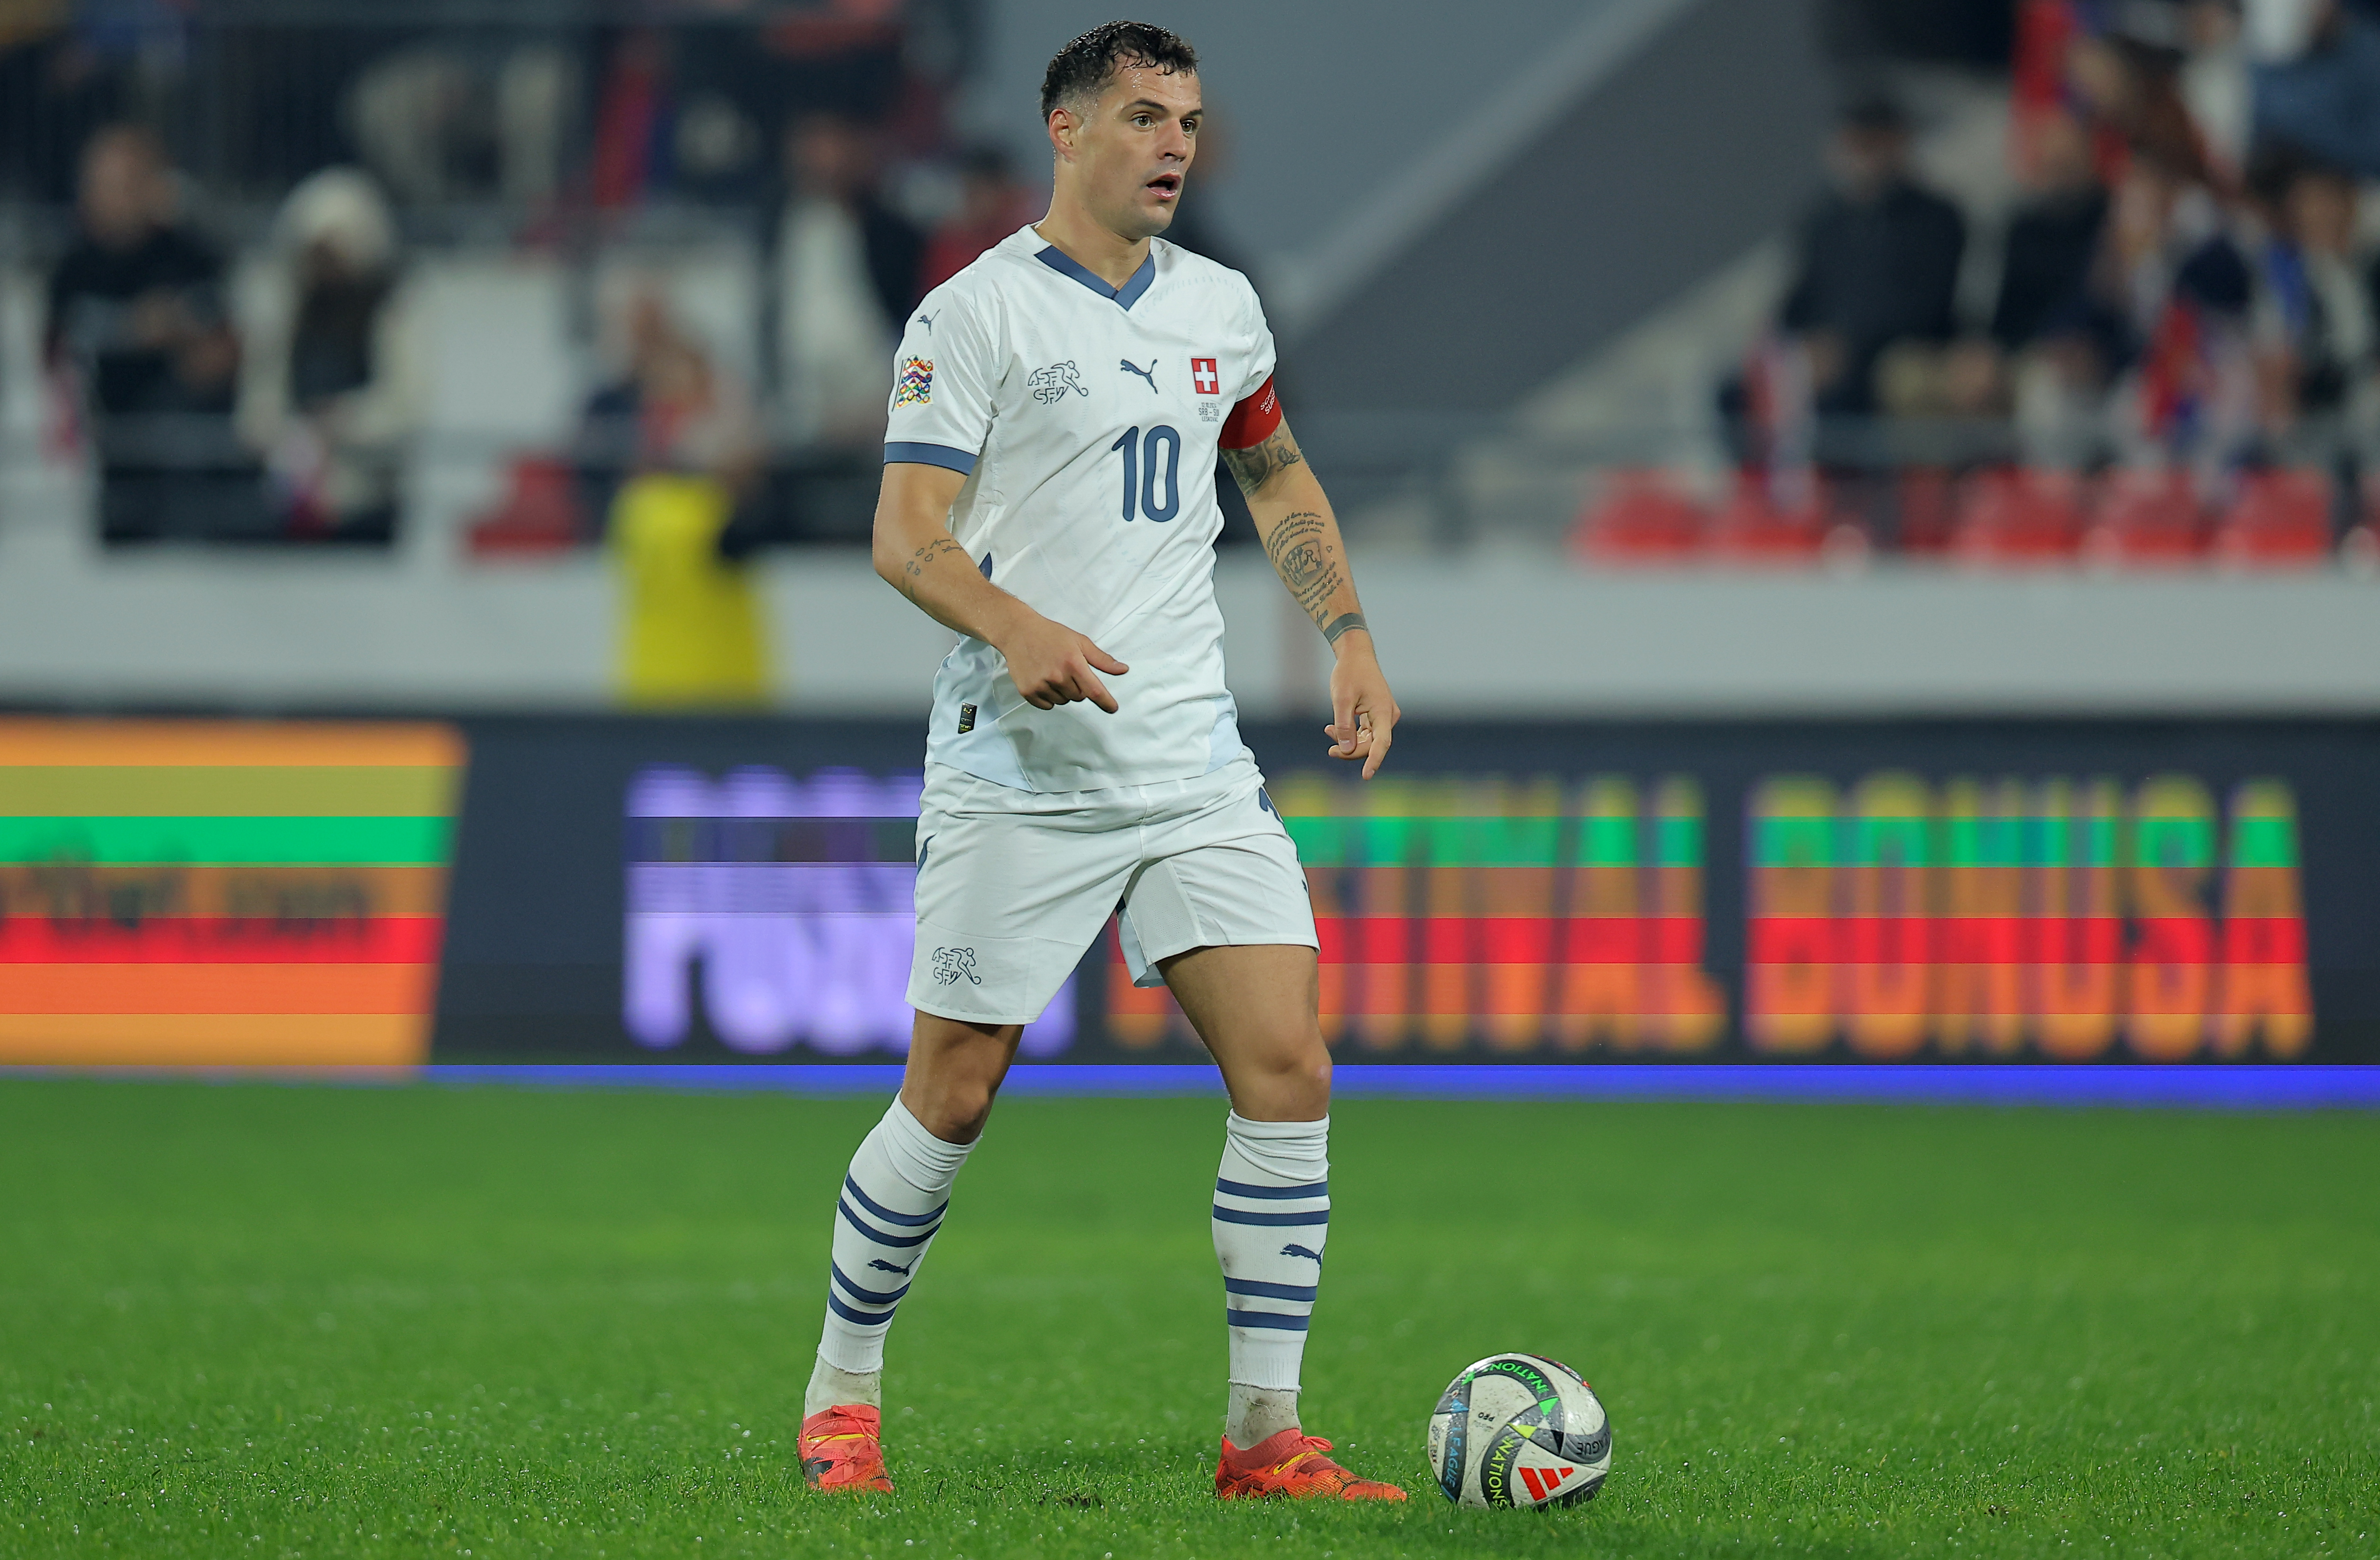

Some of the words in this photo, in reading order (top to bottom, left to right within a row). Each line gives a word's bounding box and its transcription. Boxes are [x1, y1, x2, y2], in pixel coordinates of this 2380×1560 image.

[1111, 425, 1180, 522] 10
[1304, 550, 1317, 566] R
[1744, 771, 2312, 1056] BONUSA
[1482, 1363, 1548, 1390] NATION
[1488, 1439, 1514, 1509] NATIONS
